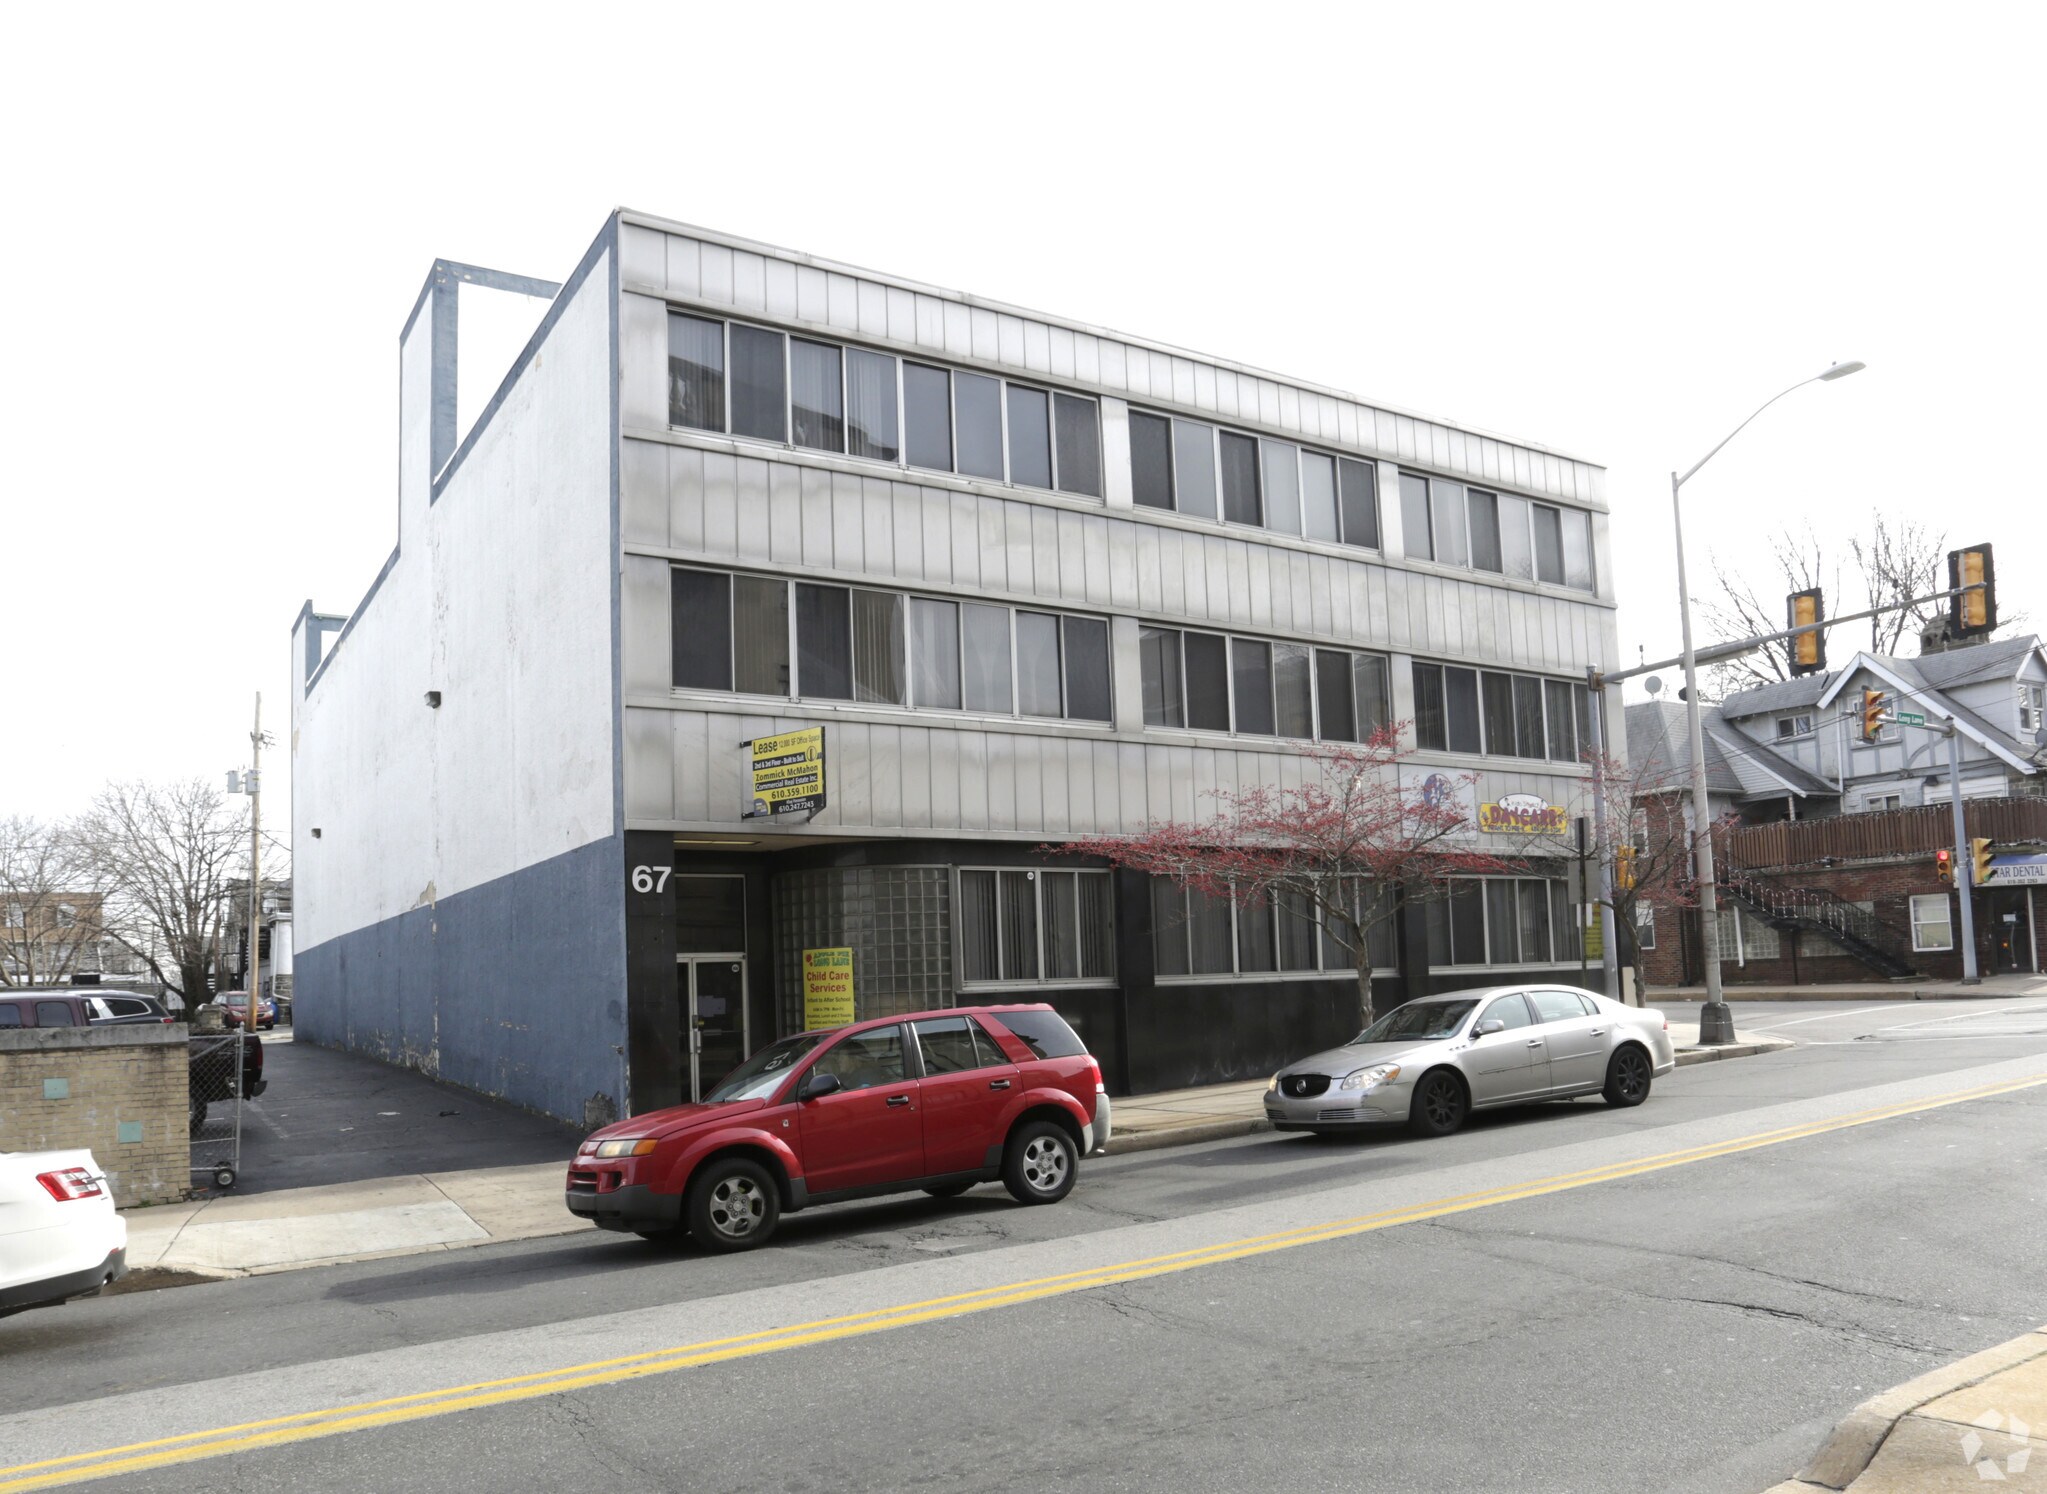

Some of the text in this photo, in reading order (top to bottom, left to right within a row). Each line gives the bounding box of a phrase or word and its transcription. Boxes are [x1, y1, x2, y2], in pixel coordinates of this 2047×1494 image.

[1899, 714, 1923, 724] Long Lane
[753, 741, 777, 755] Lease
[797, 736, 807, 744] Office
[808, 734, 820, 743] Space
[756, 765, 818, 781] Zommick McMahon
[756, 780, 783, 790] Commercial
[785, 778, 794, 786] Real
[796, 776, 809, 784] Estate
[772, 784, 818, 799] 610.359.1100
[779, 801, 814, 812] 610.247.7243
[1490, 806, 1558, 827] DAYCARE
[2013, 866, 2046, 877] DENTAL
[632, 865, 671, 893] 67
[831, 957, 849, 966] LANE
[807, 971, 849, 981] Child Care
[810, 983, 846, 992] Services
